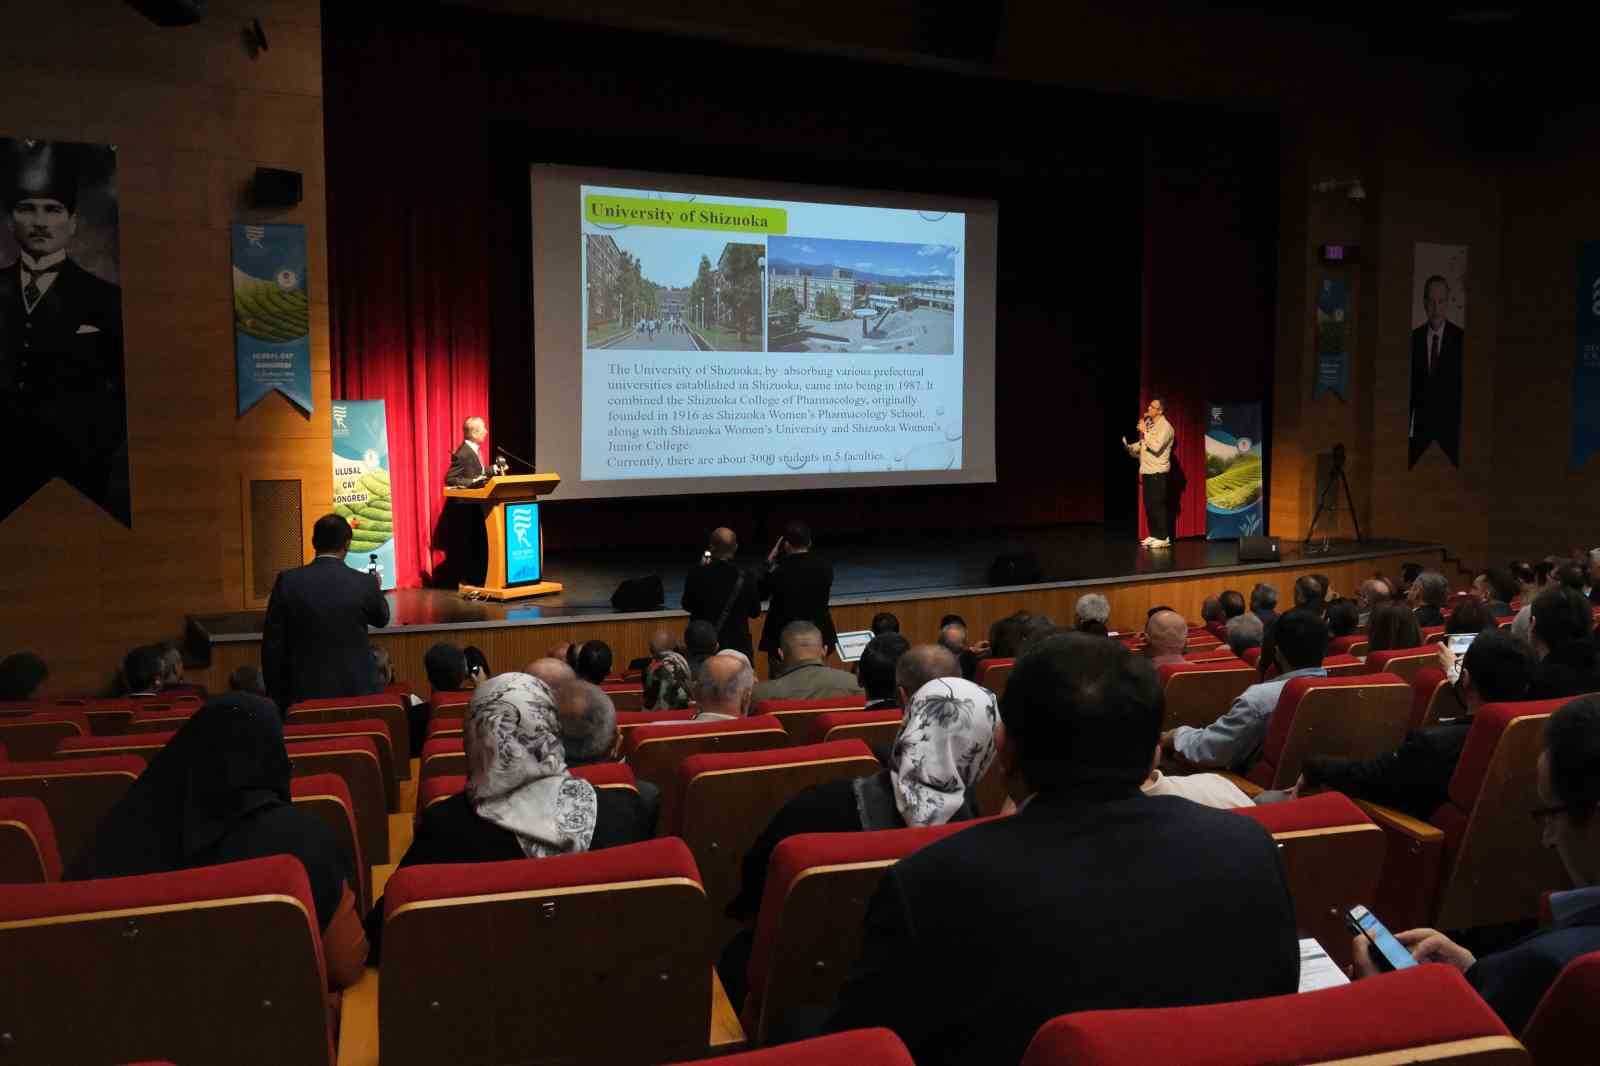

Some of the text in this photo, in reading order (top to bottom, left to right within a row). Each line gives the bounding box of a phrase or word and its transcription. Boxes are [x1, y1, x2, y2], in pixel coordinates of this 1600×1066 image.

[592, 202, 768, 227] University of Shizuoka
[608, 363, 630, 375] The
[634, 363, 690, 377] University
[695, 364, 706, 375] of
[765, 365, 777, 378] by
[784, 366, 832, 378] absorbing
[836, 367, 871, 376] various
[873, 367, 924, 378] prefectural
[608, 380, 672, 391] universities
[676, 380, 735, 391] established
[740, 380, 749, 390] in
[805, 383, 831, 391] came
[834, 381, 853, 391] into
[856, 380, 882, 393] being
[885, 380, 894, 390] in
[927, 379, 935, 390] It
[608, 394, 663, 406] combined
[668, 394, 684, 405] the
[688, 394, 736, 406] Shizuoka
[740, 394, 780, 407] College
[783, 394, 794, 405] of
[872, 394, 918, 406] originally
[608, 410, 654, 421] founded
[658, 410, 668, 421] in
[673, 409, 699, 421] 1916
[703, 412, 713, 420] as
[718, 409, 766, 421] Shizuoka
[818, 409, 887, 422] Pharmacology
[608, 426, 640, 439] along
[643, 425, 668, 436] with
[672, 425, 720, 436] Shizuoka
[724, 424, 773, 436] Women's
[776, 423, 828, 435] University
[832, 423, 849, 433] and
[852, 423, 896, 433] Shizuoka
[608, 440, 642, 452] Junior
[607, 455, 664, 469] Currently,
[668, 455, 694, 466] there
[699, 455, 714, 465] are
[717, 454, 747, 465] about
[778, 452, 819, 463] students
[823, 452, 832, 462] in
[835, 451, 842, 461] 5
[335, 466, 361, 476] ULUSAL
